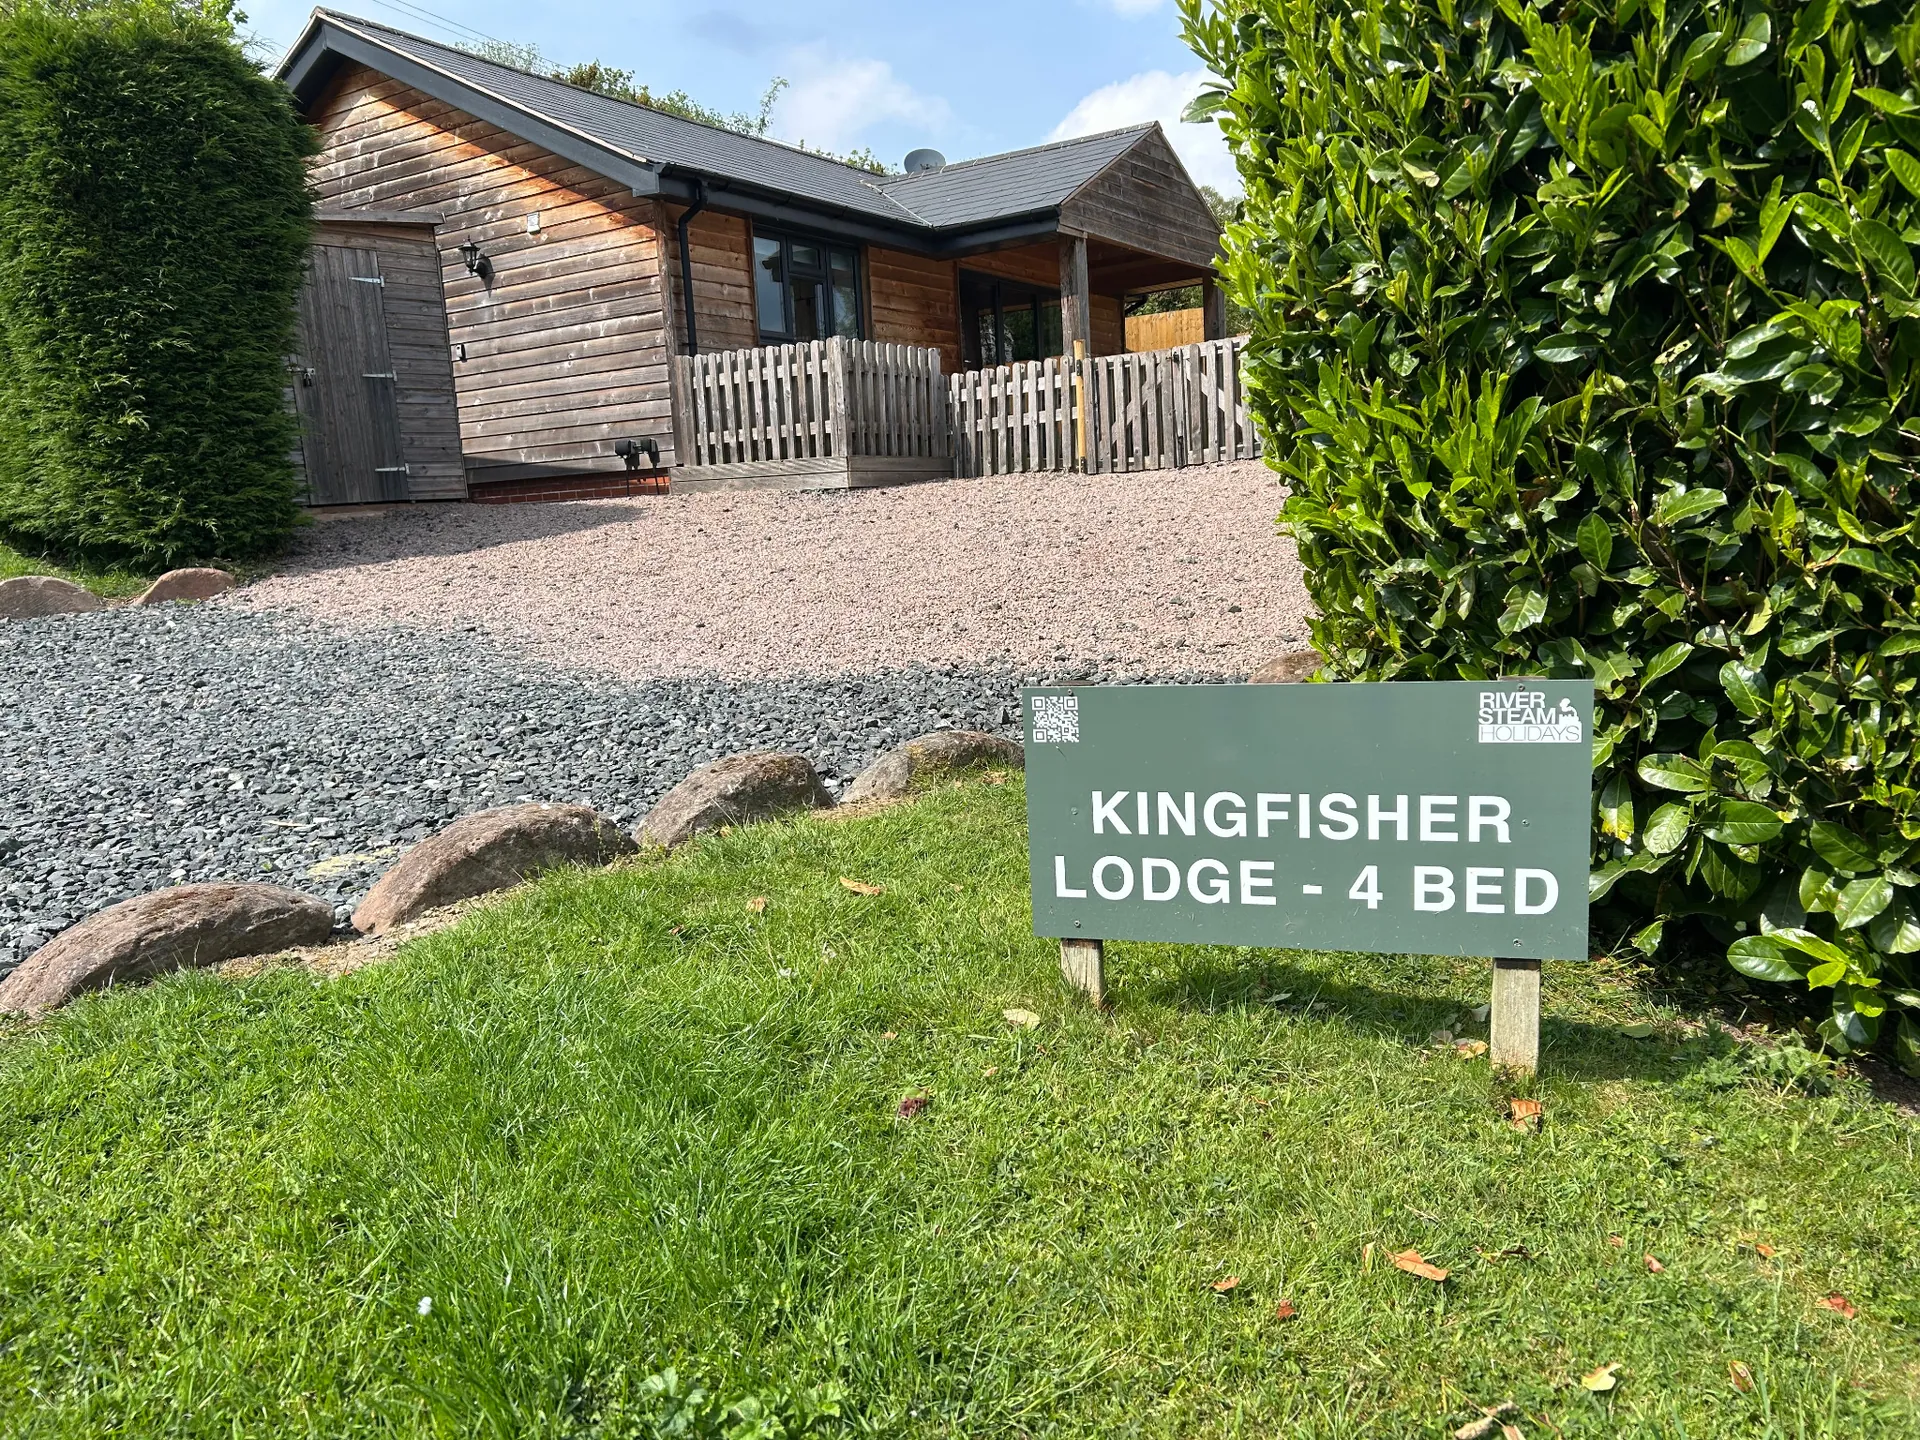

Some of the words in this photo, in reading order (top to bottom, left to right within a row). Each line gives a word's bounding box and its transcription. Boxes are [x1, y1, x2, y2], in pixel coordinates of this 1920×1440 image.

[1480, 692, 1546, 709] RIVER
[1478, 707, 1557, 725] STEAM
[1480, 725, 1580, 742] HOLIDAYS
[1091, 790, 1512, 843] KINGFISHER
[1054, 855, 1277, 906] LODGE
[1302, 884, 1323, 895] -
[1349, 865, 1384, 910] 4
[1413, 865, 1559, 915] BED
